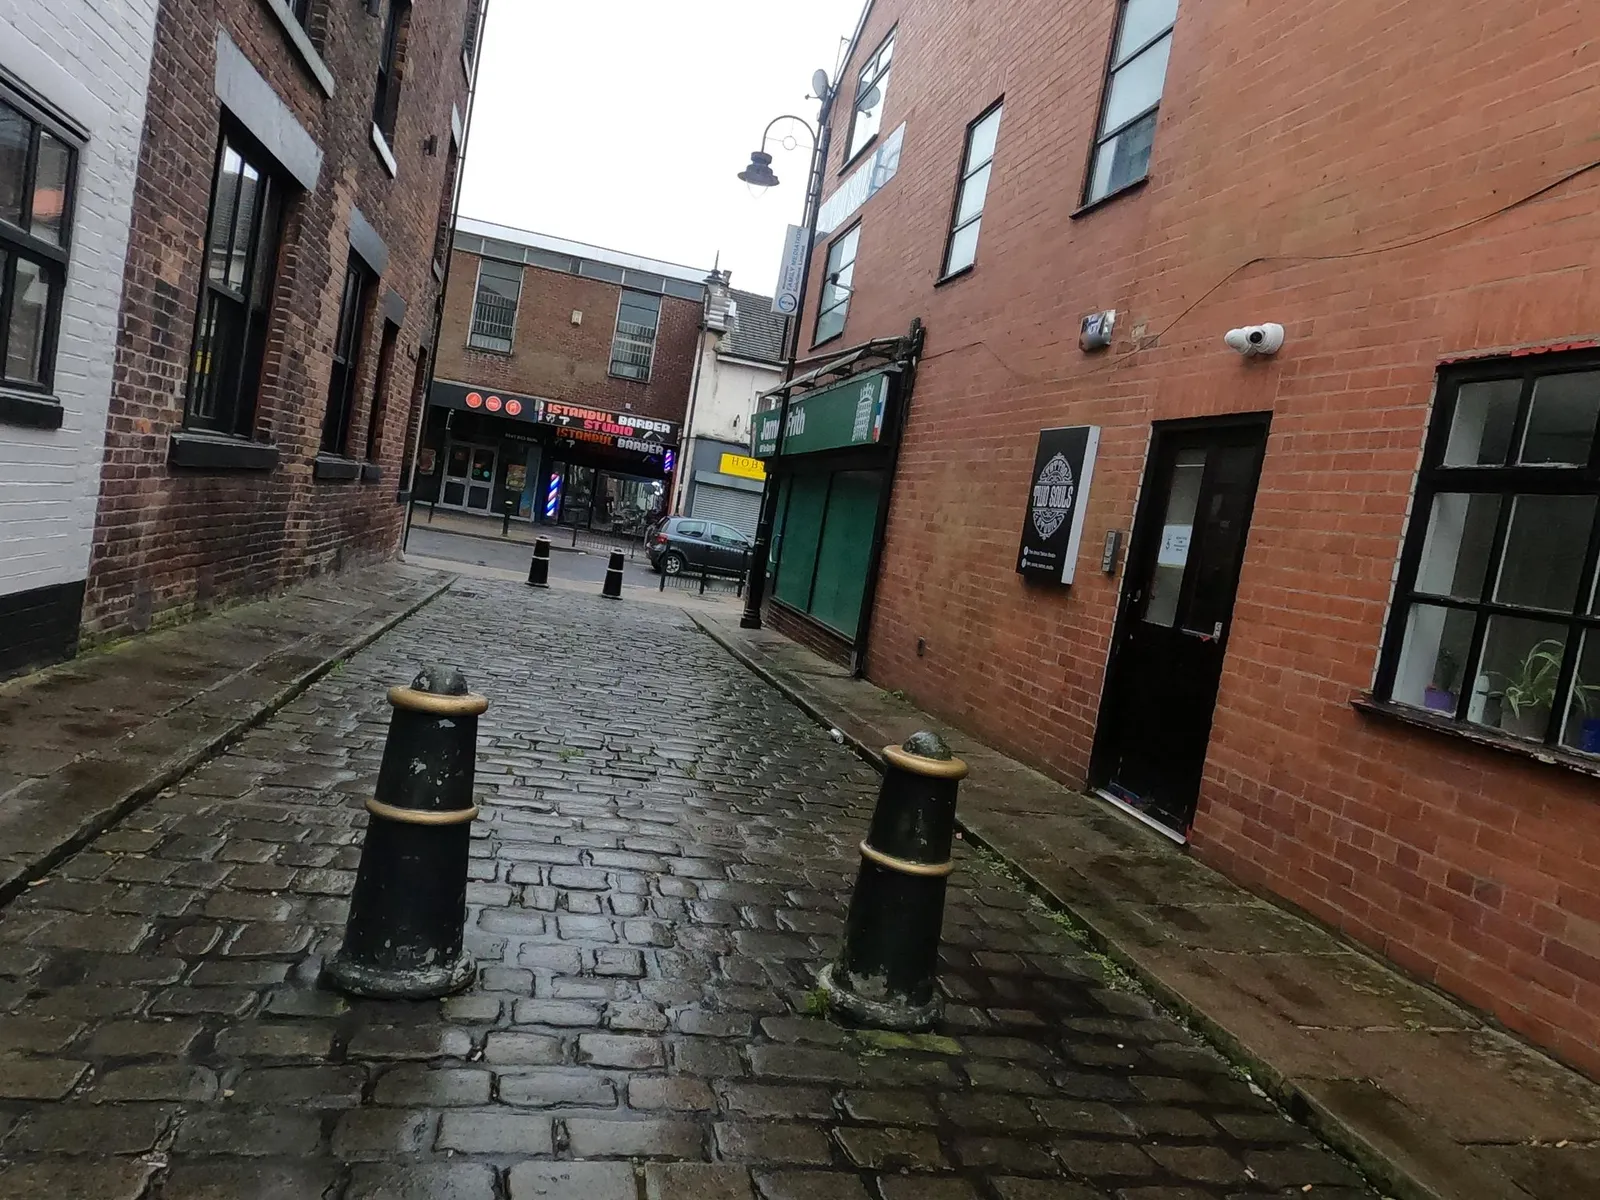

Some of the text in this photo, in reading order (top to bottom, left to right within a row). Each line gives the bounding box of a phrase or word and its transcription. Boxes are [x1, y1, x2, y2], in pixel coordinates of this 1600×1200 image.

[547, 403, 671, 434] ISTANBUL BARBER
[583, 421, 634, 437] STUDIO
[556, 427, 614, 446] ISTANBUL
[617, 438, 664, 455] BARBER
[1033, 485, 1074, 509] TWO SOULS
